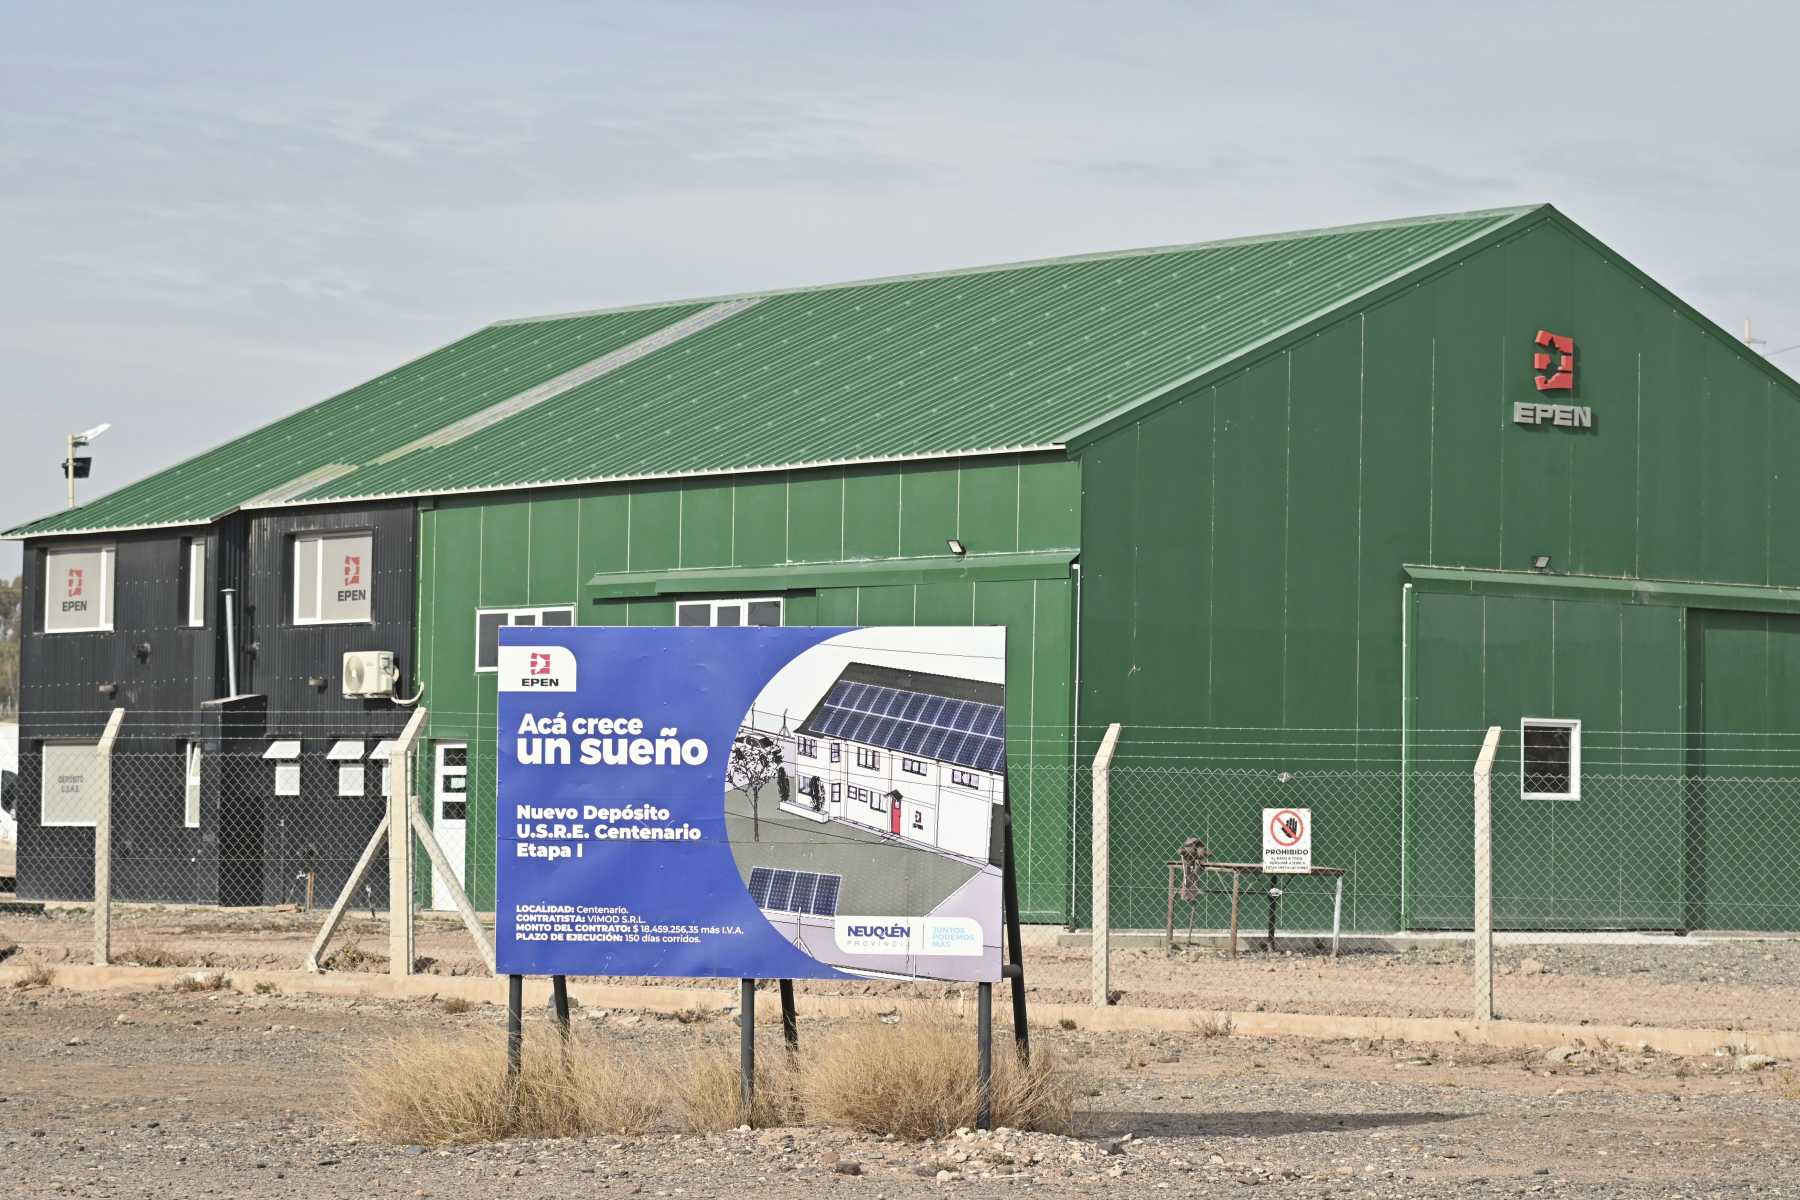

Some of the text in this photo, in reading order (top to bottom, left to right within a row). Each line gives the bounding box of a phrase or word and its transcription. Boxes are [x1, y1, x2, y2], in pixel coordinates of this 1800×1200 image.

[1513, 401, 1592, 427] EPEN
[337, 589, 366, 602] EPEN
[62, 601, 88, 612] EPEN
[521, 678, 559, 687] EPEN
[517, 712, 644, 735] Acá crece
[517, 727, 709, 766] un sueño
[516, 804, 670, 824] Nuevo Depósito
[516, 824, 702, 840] U.S.R.E. Centenario
[516, 843, 583, 861] Etapa I
[516, 905, 629, 914] LOCALIDAD: Centenario.
[516, 914, 585, 923] CONTRATISTA:
[621, 916, 646, 924] S.R.L.
[516, 924, 744, 935] MONTO DEL CONTRATO: $ 18.459.256,35 más I.V.A.
[847, 923, 911, 939] NEUQUÉN
[516, 933, 548, 941] PLAZO
[566, 932, 623, 942] EJECUCIÓN:
[625, 934, 640, 942] 150
[642, 934, 660, 943] días
[662, 935, 701, 944] corridos.
